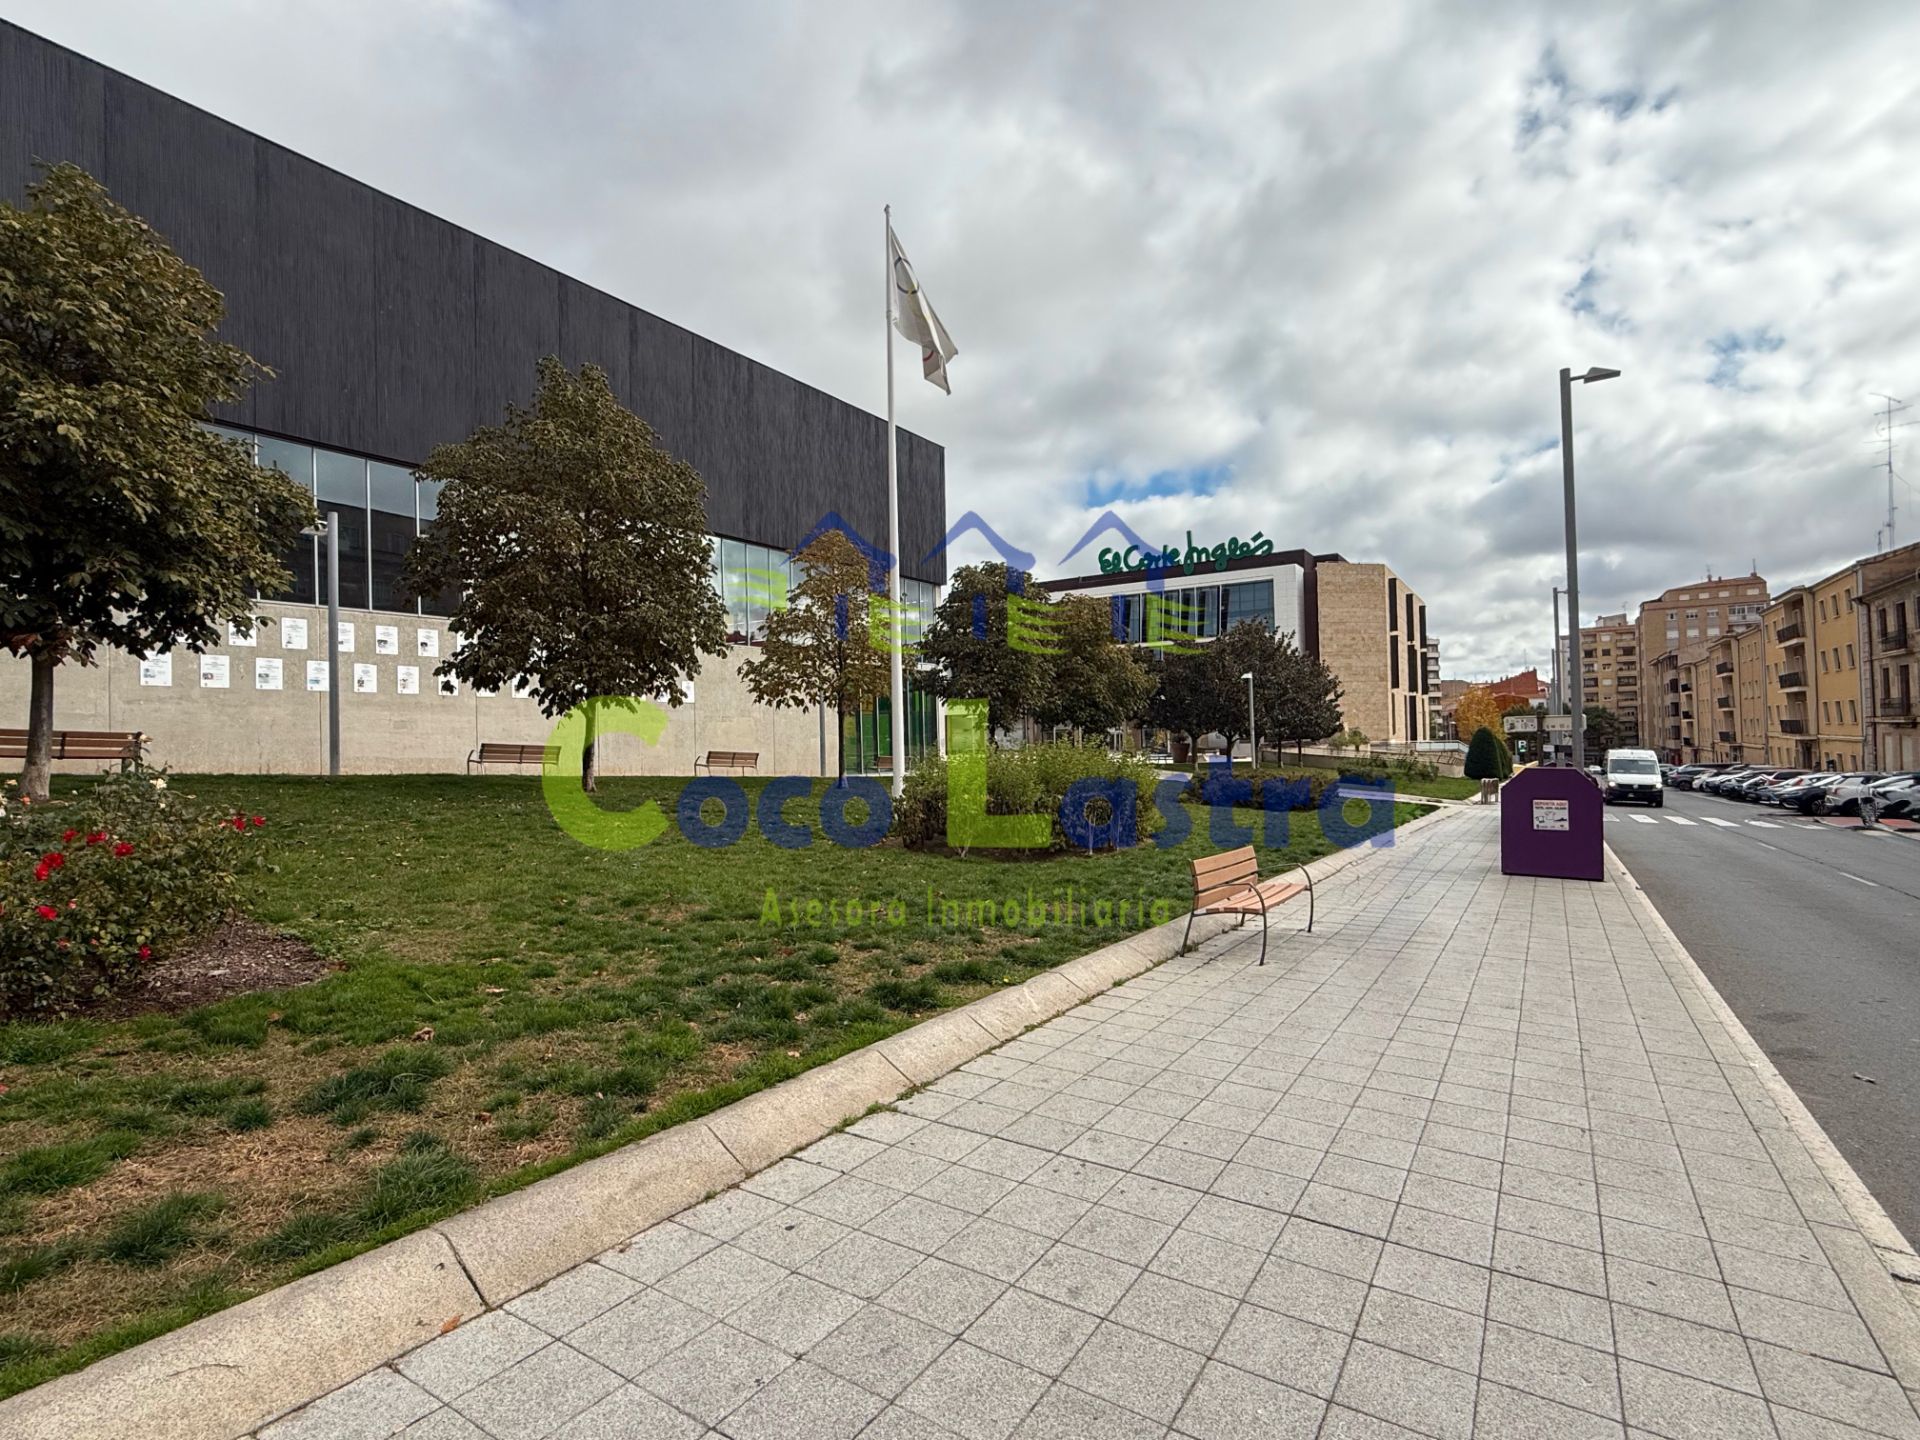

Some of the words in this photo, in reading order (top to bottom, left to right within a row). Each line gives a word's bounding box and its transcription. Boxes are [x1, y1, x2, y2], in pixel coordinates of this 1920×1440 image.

[1098, 547, 1122, 575] El
[1123, 544, 1181, 572] Corte
[1183, 530, 1274, 576] Inglés
